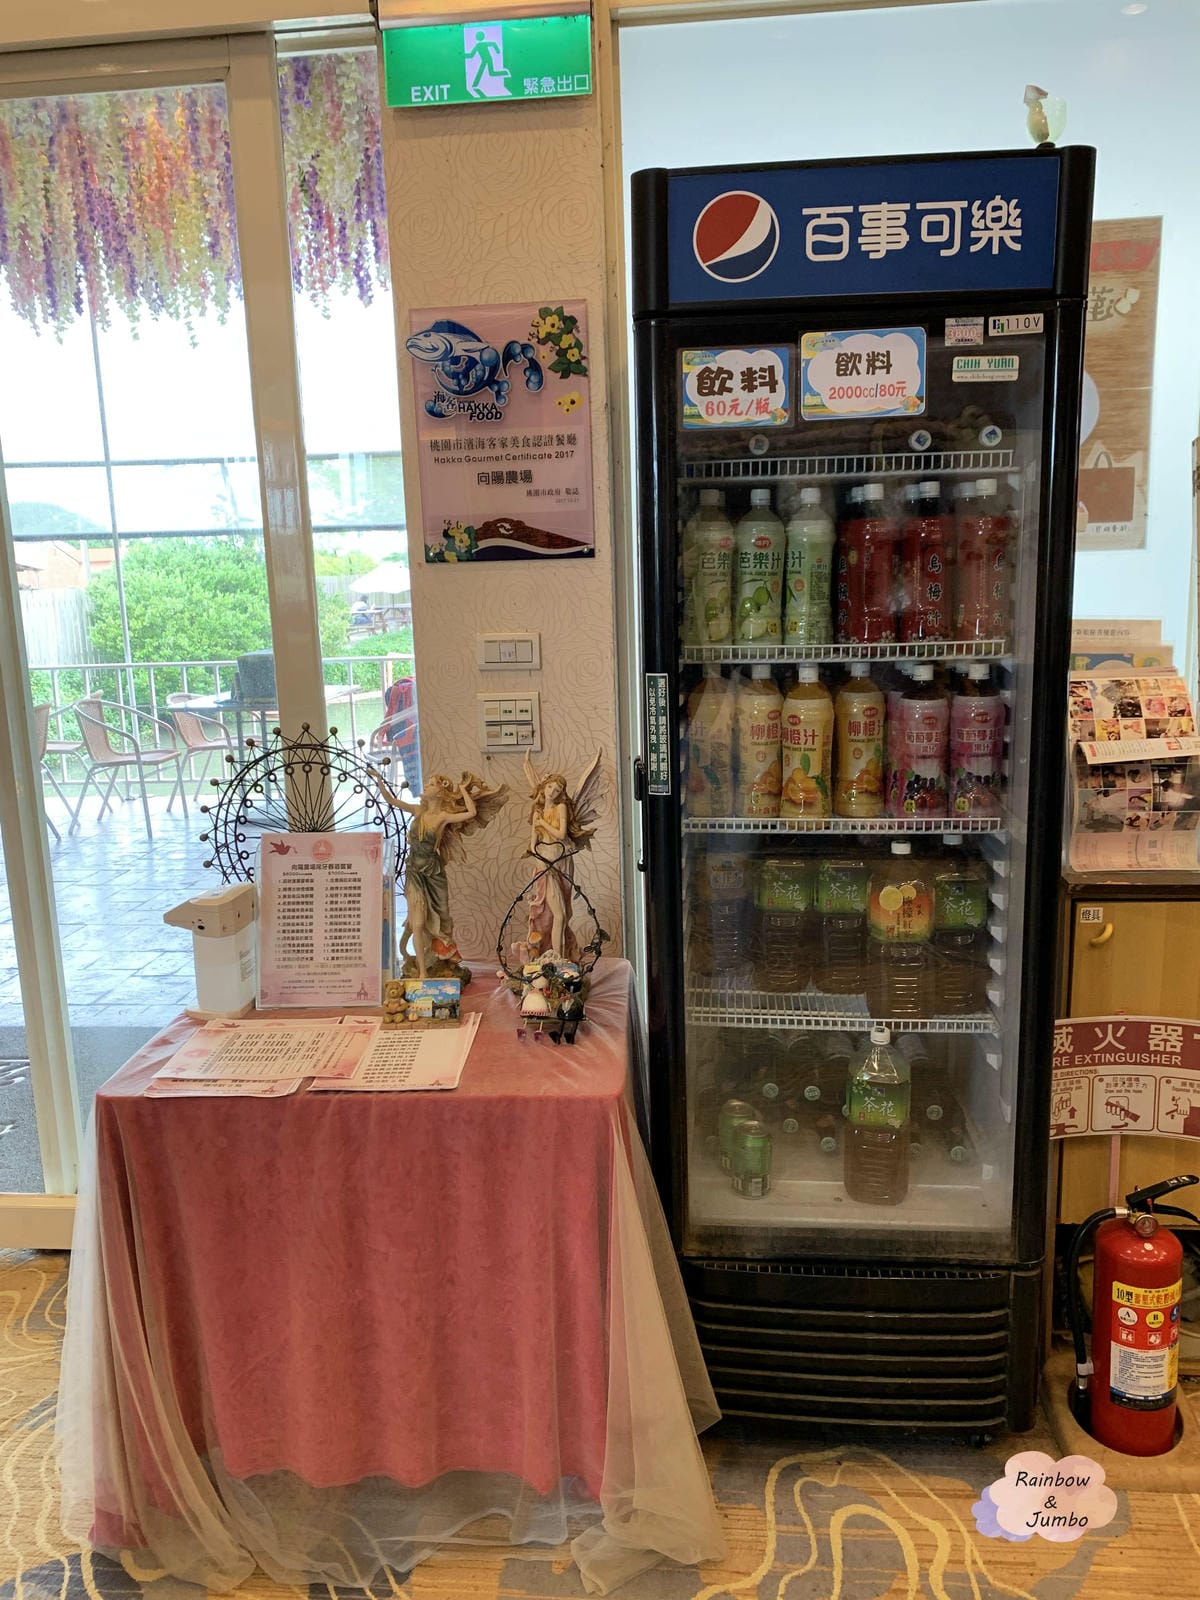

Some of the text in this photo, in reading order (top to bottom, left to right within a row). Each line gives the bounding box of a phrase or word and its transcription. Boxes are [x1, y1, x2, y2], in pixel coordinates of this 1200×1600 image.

[411, 85, 450, 102] EXIT
[523, 74, 589, 95] 緊急出口
[802, 195, 1022, 262] 百事可樂
[1006, 317, 1040, 330] 110V
[835, 350, 894, 377] 飲料
[696, 364, 779, 397] 飲料
[828, 380, 908, 401] 2000cc/80元
[458, 402, 498, 413] HAKKA
[469, 411, 503, 421] FOOD
[704, 397, 774, 418] 60元/瓶
[430, 433, 577, 452] 桃園市濱海客家美食認證餐廳
[434, 450, 575, 464] Hakka Gourmet Certificate 2017
[477, 469, 533, 486] 向陽農場
[739, 551, 782, 570] 芭樂汁
[928, 553, 942, 628] 烏梅汁
[771, 882, 802, 900] 茶花
[829, 883, 859, 901] 茶花
[943, 897, 976, 916] 茶花
[1053, 1023, 1184, 1054] 滅火器
[1053, 1052, 1182, 1068] RE EXTINGUISHER
[863, 1097, 897, 1118] 茶花
